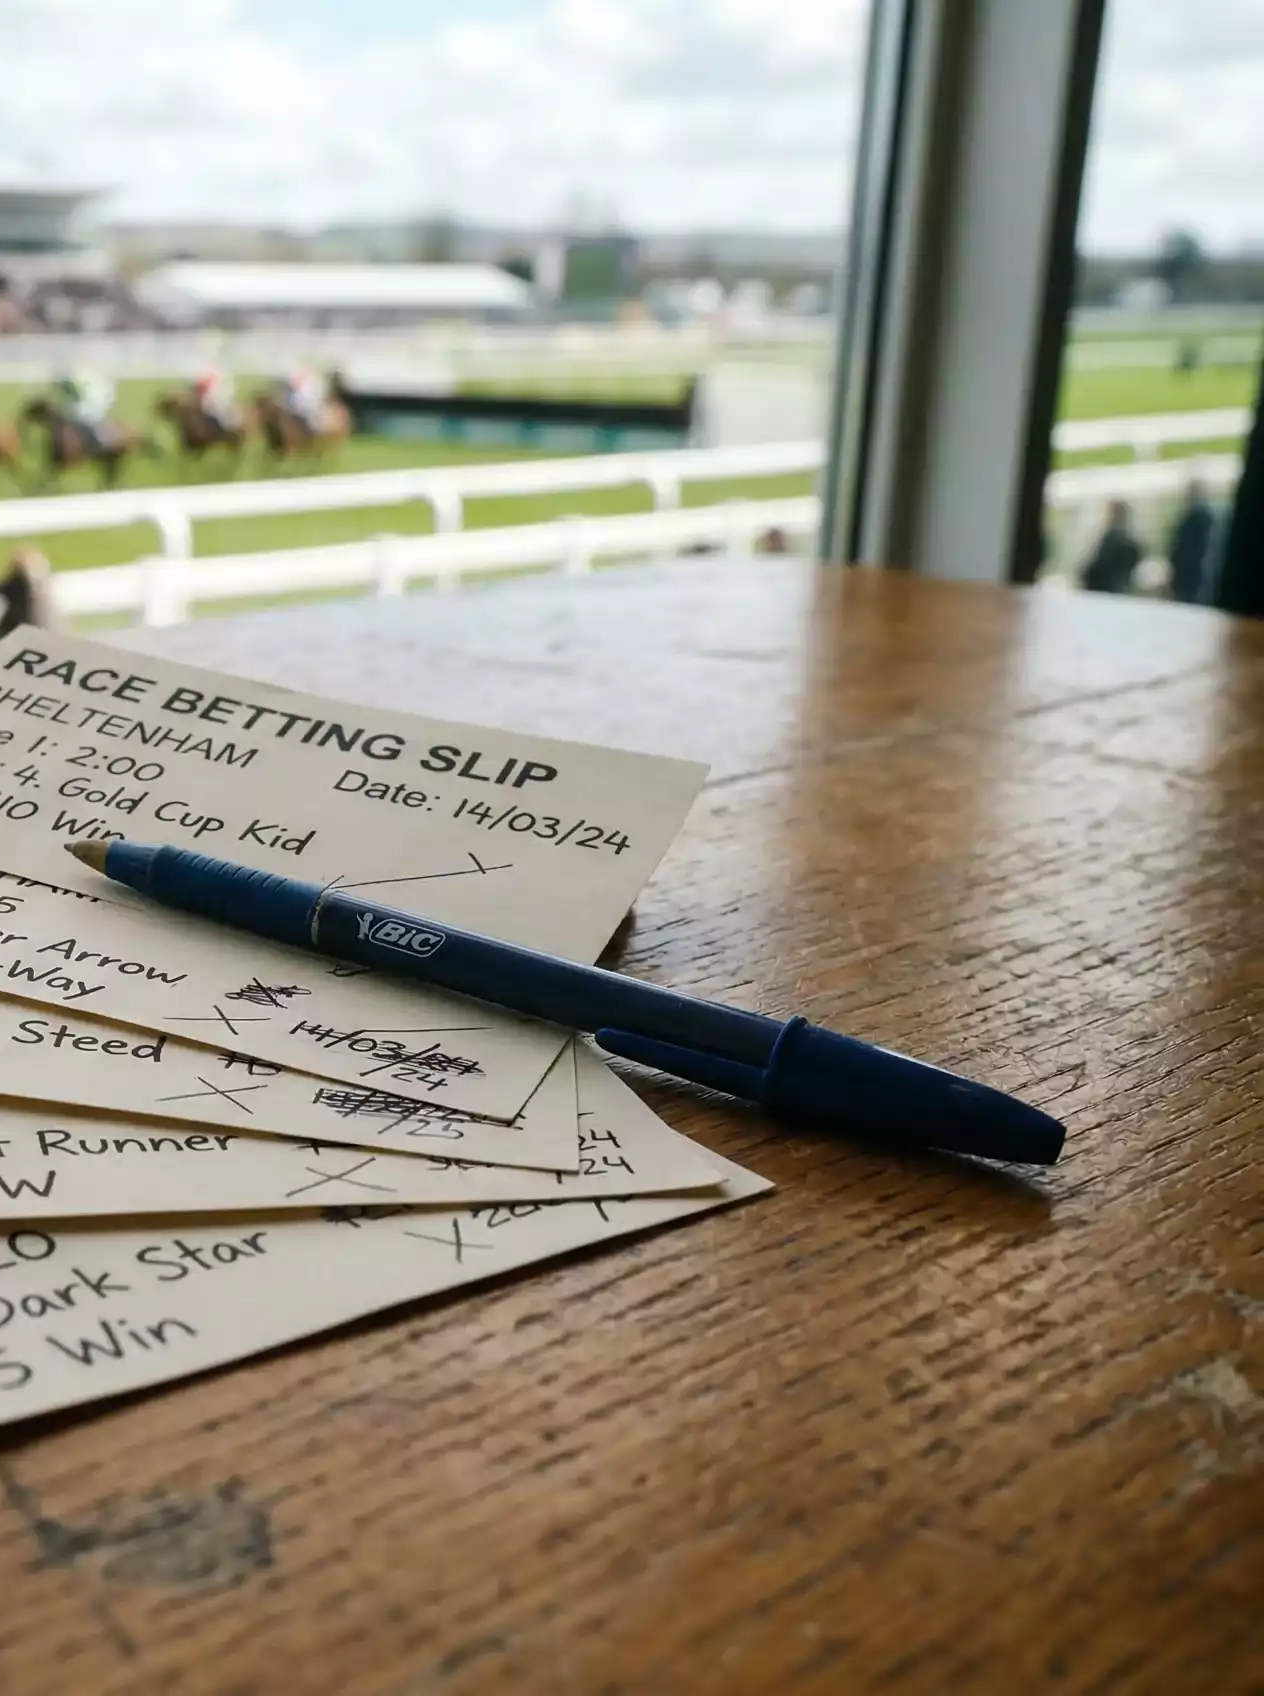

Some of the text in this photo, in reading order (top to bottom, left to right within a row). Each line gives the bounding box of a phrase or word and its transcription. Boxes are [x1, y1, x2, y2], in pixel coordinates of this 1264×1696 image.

[3, 648, 558, 789] RACE BETTING SLIP
[27, 736, 58, 756] 1:
[66, 747, 164, 782] 2:00
[13, 764, 40, 788] 4.
[58, 777, 147, 816] Gold
[154, 801, 225, 839] Cup
[239, 819, 316, 855] Kid
[333, 770, 630, 855] Date: 14/03/24
[36, 938, 188, 984] Arrow
[11, 1020, 167, 1063] Steed
[36, 1129, 239, 1157] Runner
[136, 1231, 268, 1281] Star
[46, 1318, 198, 1366] Win
